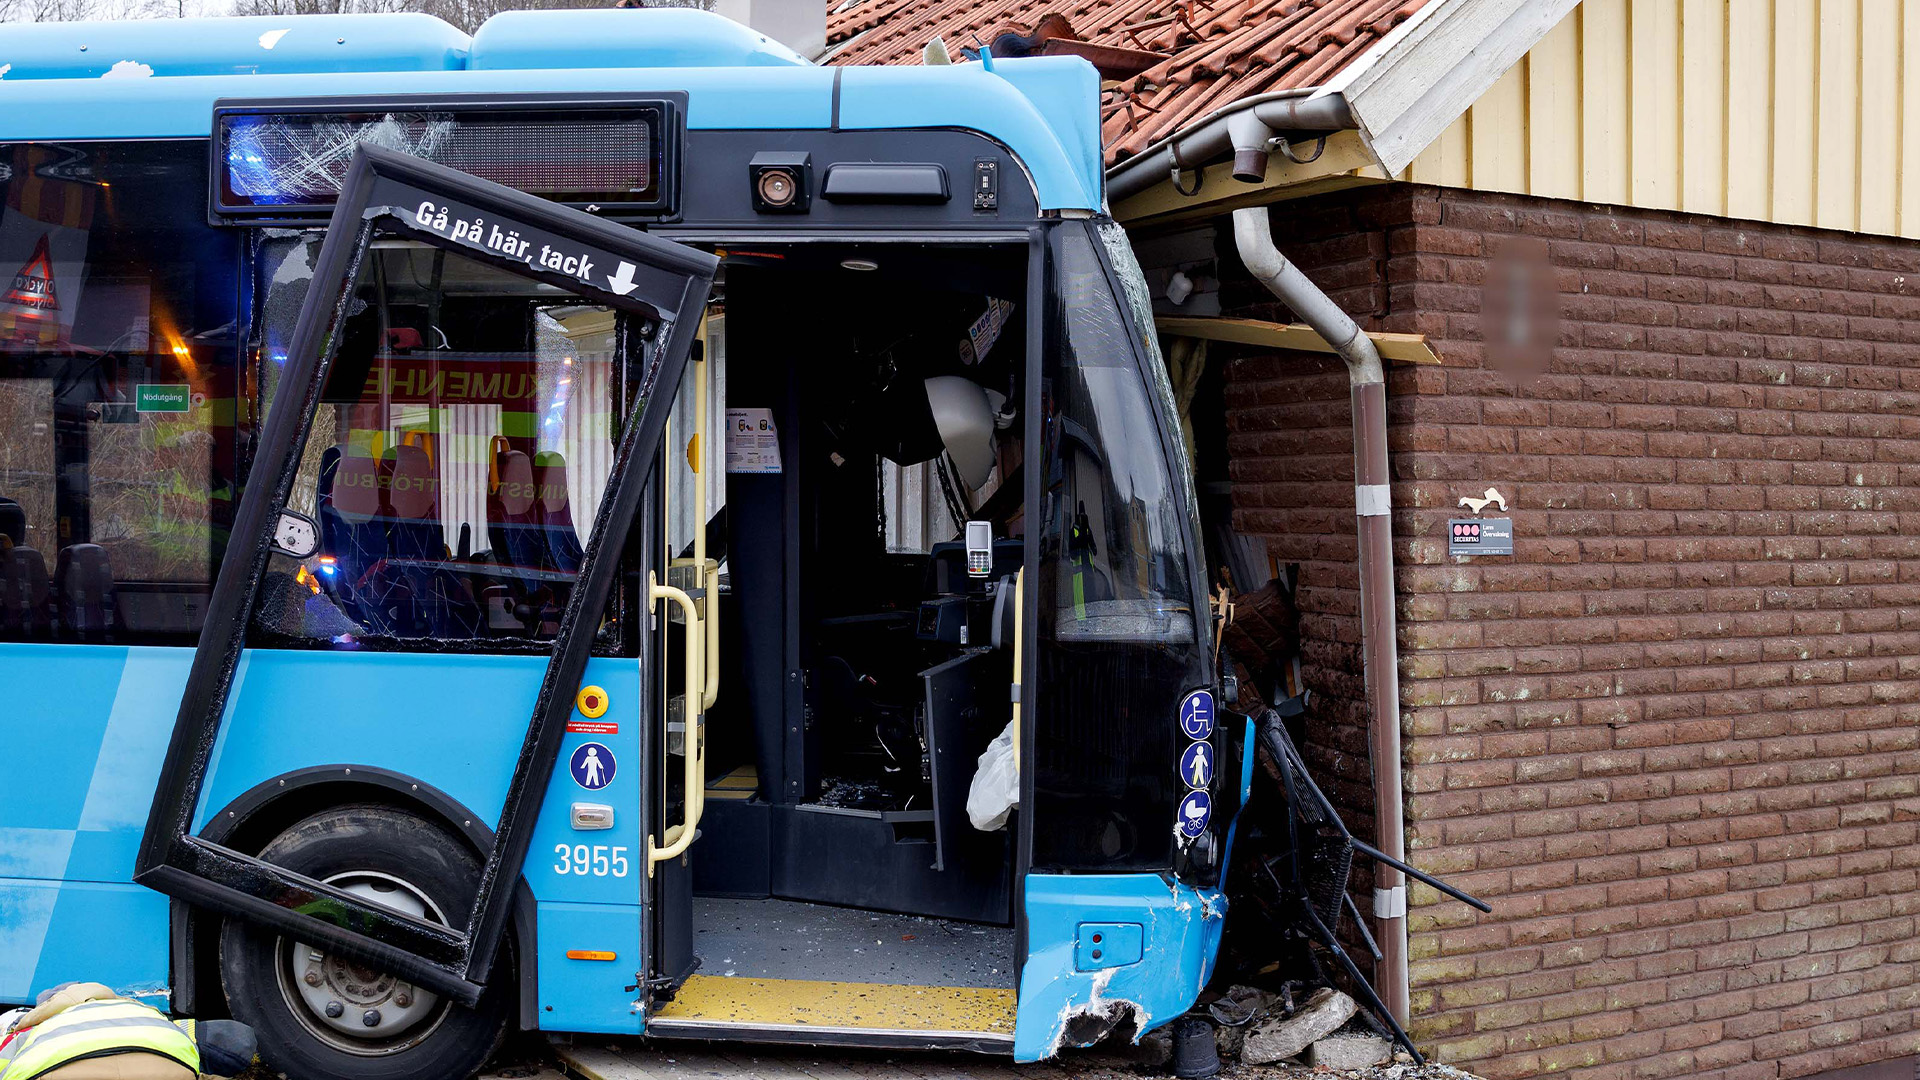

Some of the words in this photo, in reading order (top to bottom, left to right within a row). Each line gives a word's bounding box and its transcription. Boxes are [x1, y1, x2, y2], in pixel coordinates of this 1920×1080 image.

[415, 201, 449, 231] Gå
[450, 218, 484, 244] på
[487, 224, 534, 263] här,
[539, 245, 595, 280] tack
[143, 393, 183, 403] Nödutgång
[553, 843, 629, 878] 3955
